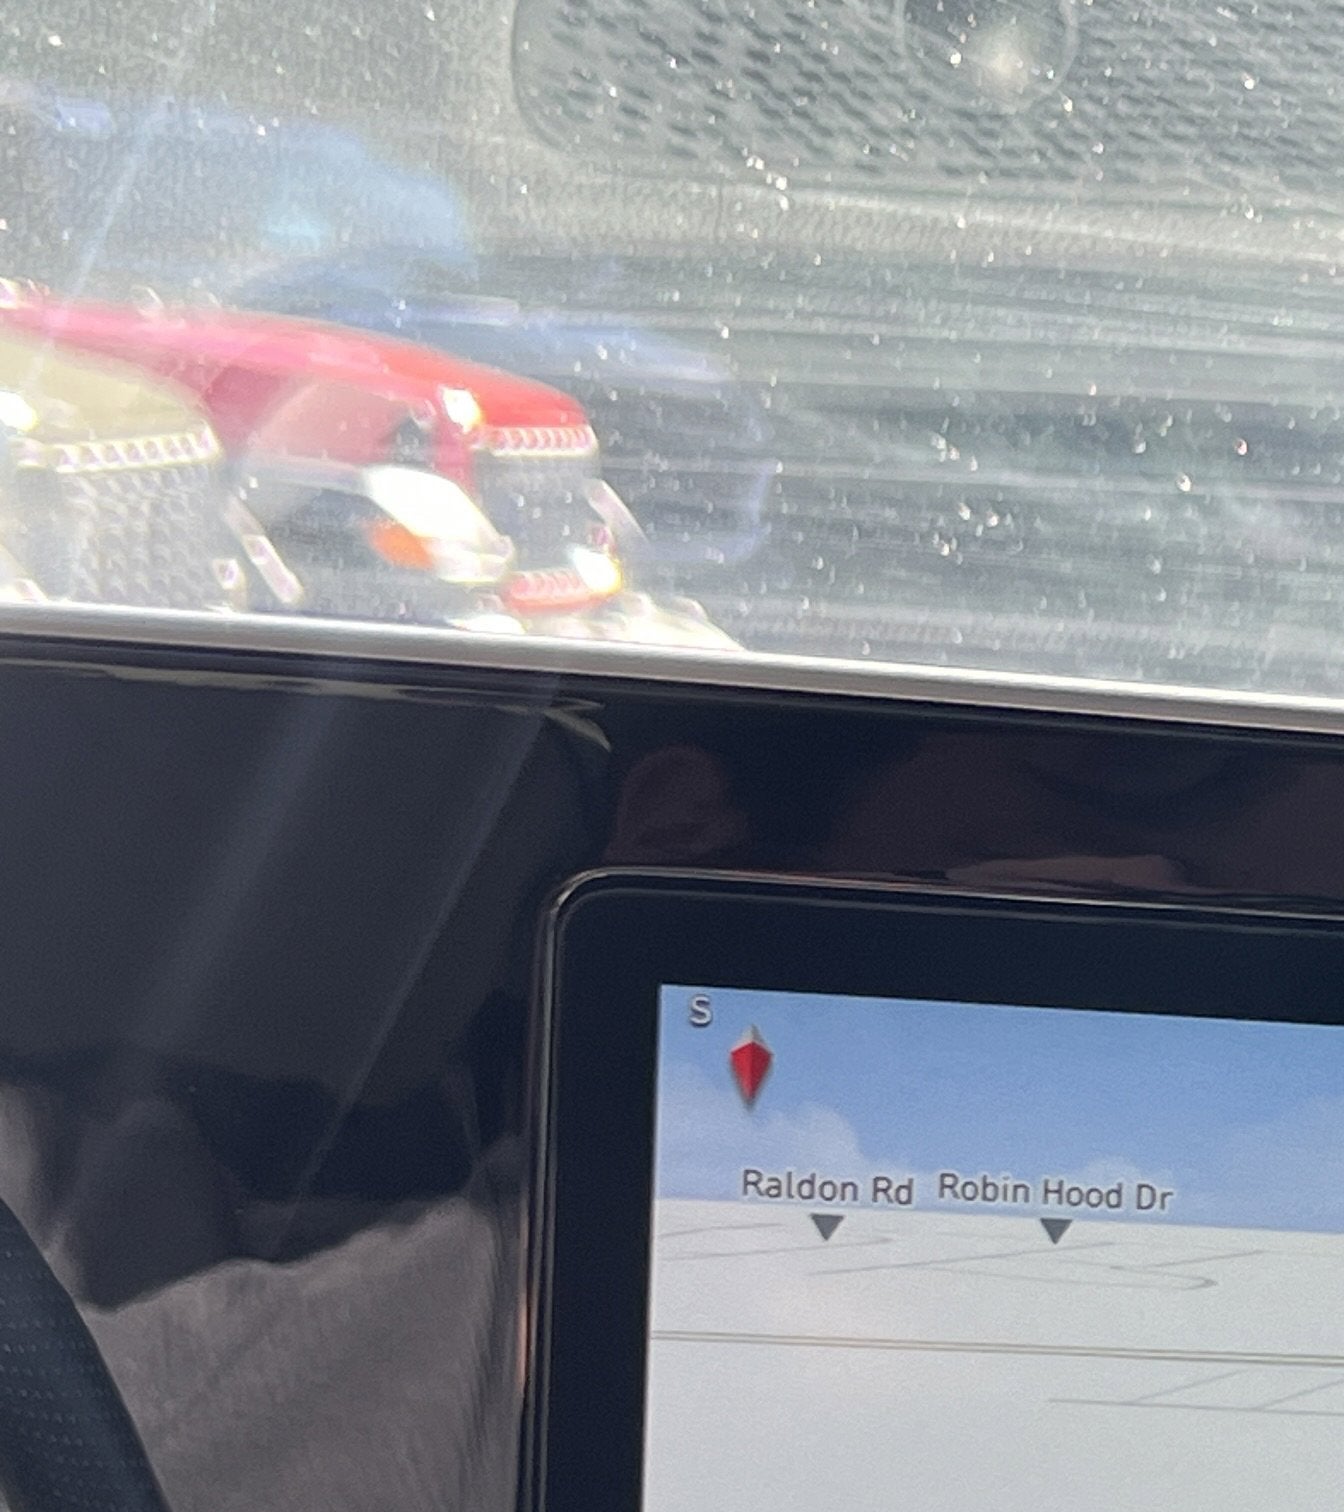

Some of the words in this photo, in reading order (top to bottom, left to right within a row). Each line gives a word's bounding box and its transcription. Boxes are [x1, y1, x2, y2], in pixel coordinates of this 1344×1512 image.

[689, 996, 713, 1027] S
[742, 1168, 858, 1203] Raldon
[871, 1176, 914, 1206] Rd
[938, 1172, 1030, 1205] Robin
[1042, 1179, 1123, 1210] Hood
[1136, 1184, 1173, 1212] Dr
